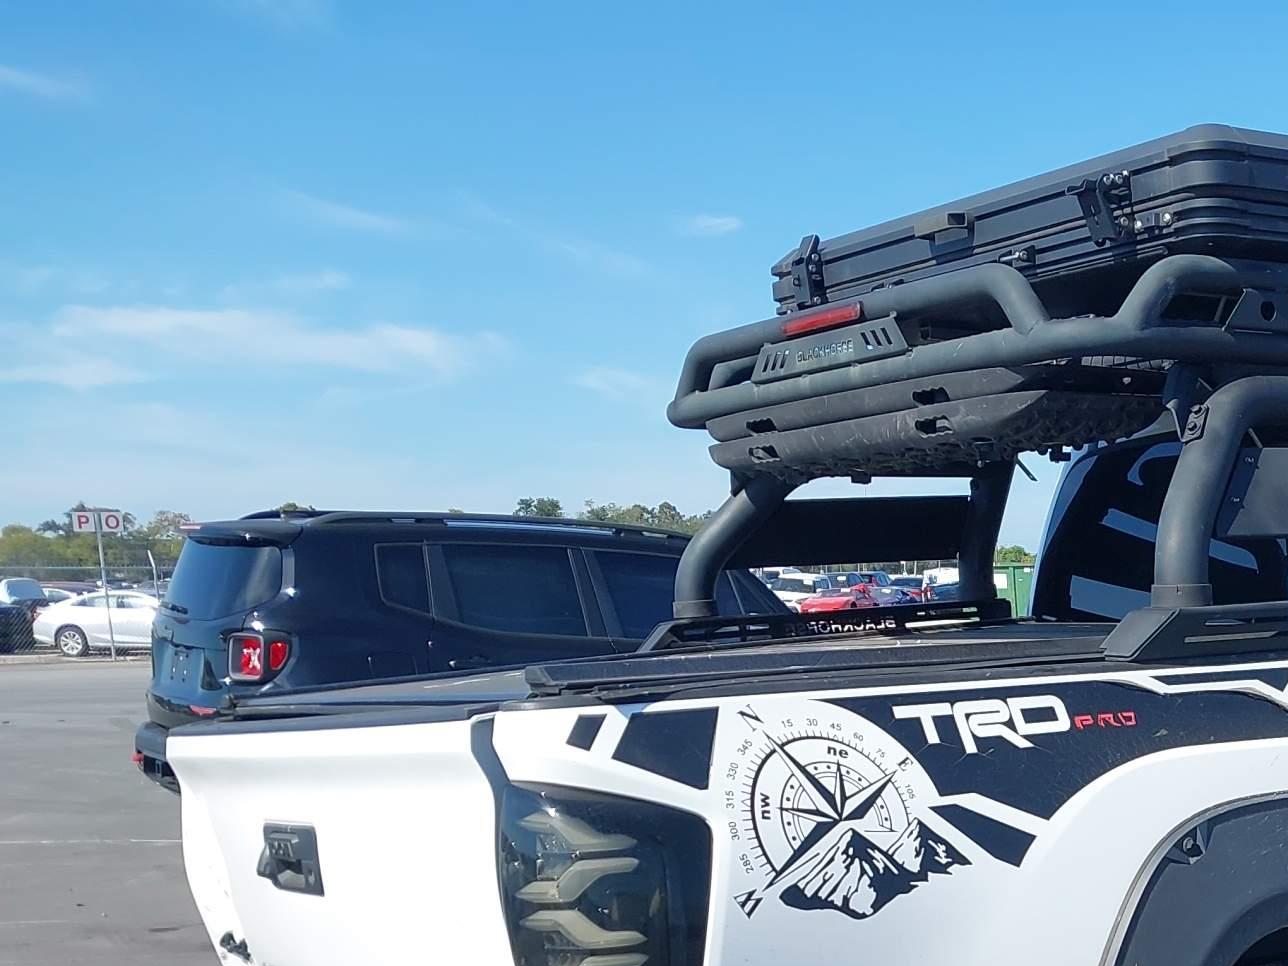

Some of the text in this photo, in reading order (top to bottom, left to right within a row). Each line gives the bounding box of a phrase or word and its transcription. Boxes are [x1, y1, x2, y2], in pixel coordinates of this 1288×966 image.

[796, 338, 854, 363] BLACKHORSE
[77, 514, 90, 529] P
[737, 703, 765, 732] N
[781, 718, 793, 729] 15
[806, 718, 818, 727] 30
[891, 694, 1137, 755] TRD PRO
[829, 722, 842, 732] 45
[852, 731, 864, 742] 60
[736, 739, 753, 757] 345
[826, 745, 849, 759] ne
[874, 747, 886, 759] 75
[726, 762, 739, 781] 330
[897, 755, 914, 772] E
[725, 790, 735, 809] 315
[903, 783, 916, 800] 105
[760, 792, 772, 821] nw
[727, 821, 741, 842] 300
[738, 853, 755, 875] 285
[733, 888, 764, 920] W
